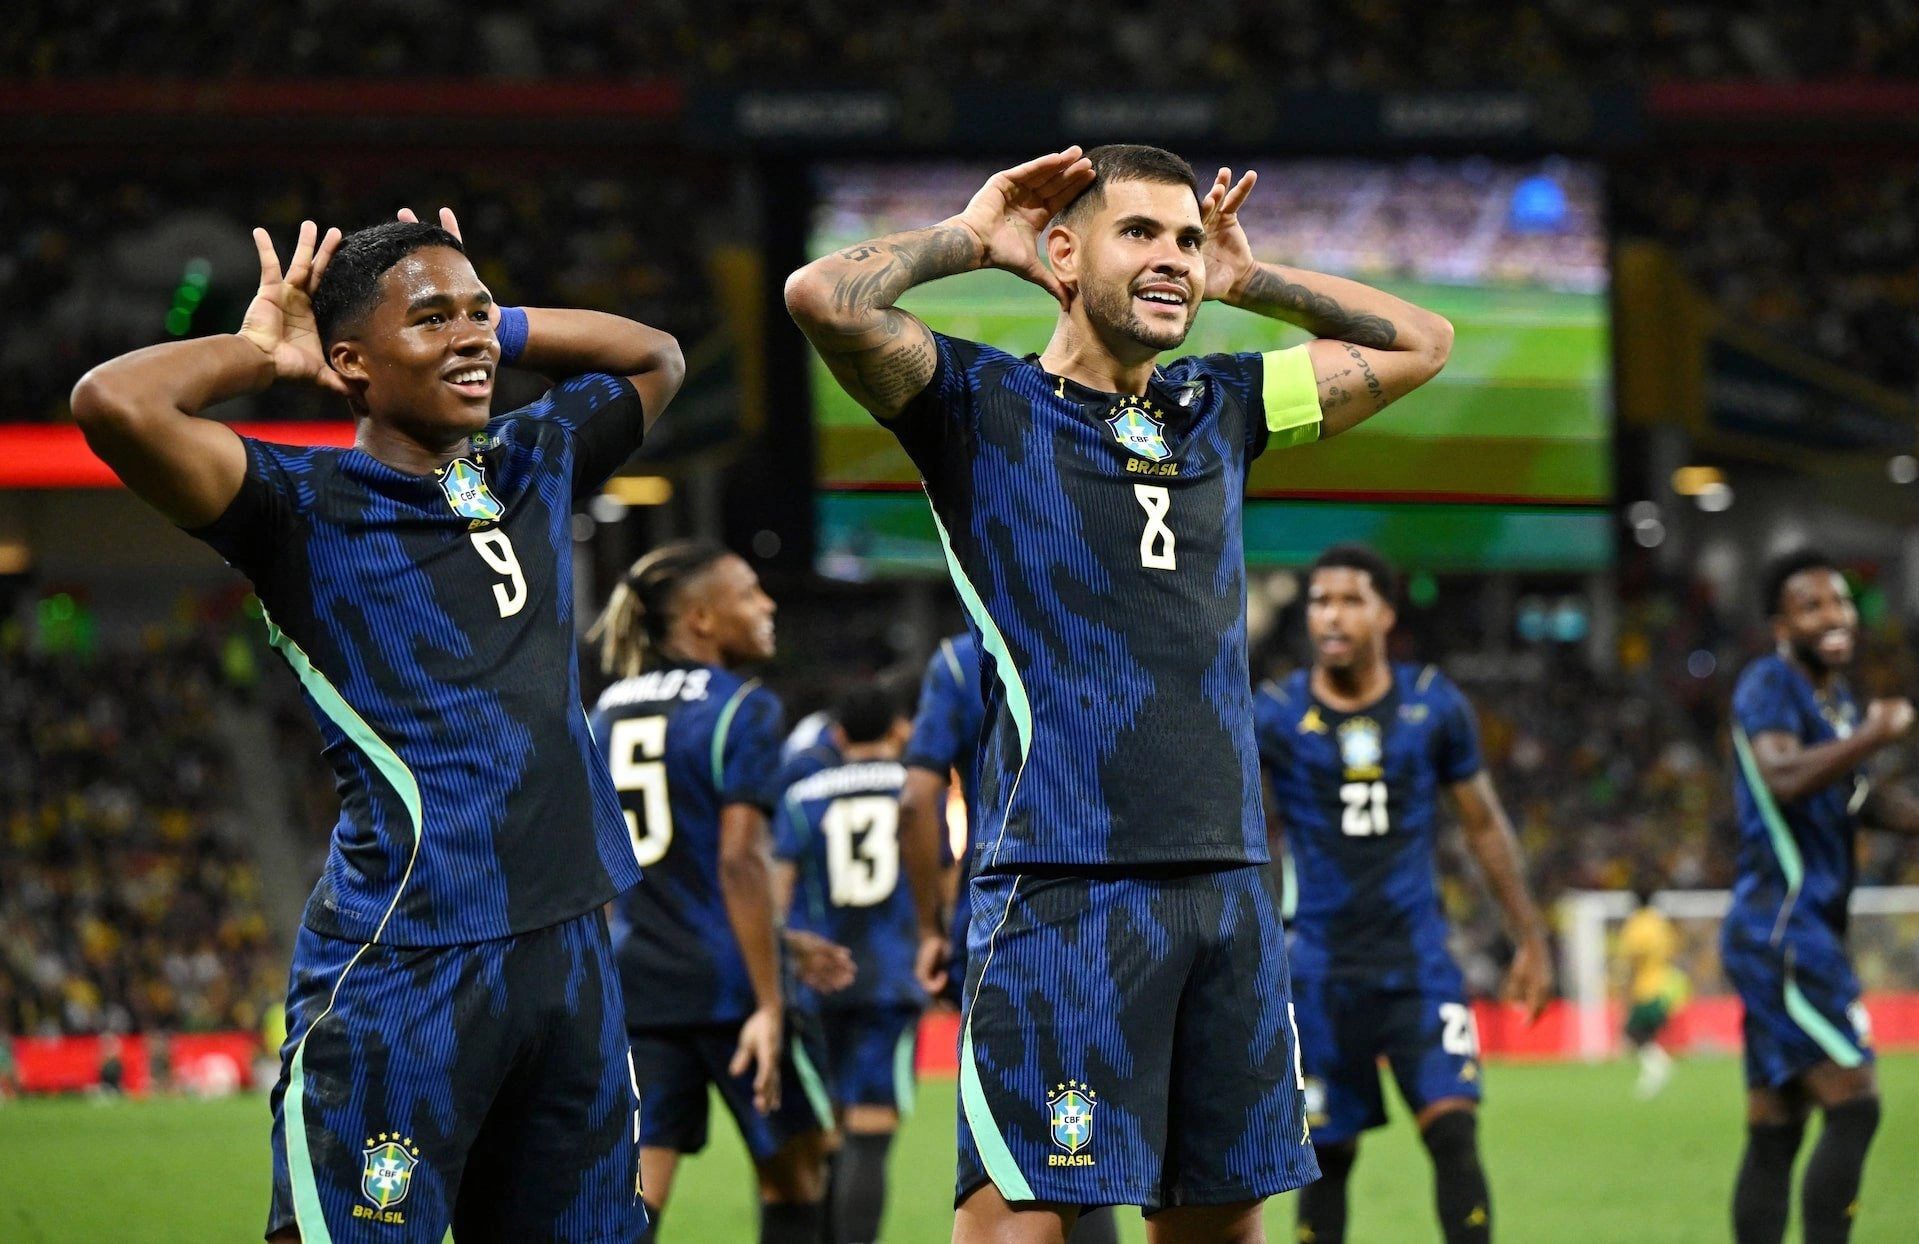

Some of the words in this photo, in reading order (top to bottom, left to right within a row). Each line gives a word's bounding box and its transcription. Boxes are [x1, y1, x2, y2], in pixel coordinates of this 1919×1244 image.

[1130, 435, 1149, 443] CBF
[1126, 457, 1179, 476] BRASIL
[460, 489, 477, 502] CBF
[1134, 483, 1177, 571] 8
[470, 527, 528, 618] 9
[609, 714, 674, 867] 5
[1339, 780, 1389, 836] 21
[820, 795, 900, 908] 13
[1064, 1116, 1081, 1124] CBF
[1048, 1154, 1096, 1167] BRASIL
[378, 1168, 398, 1179] CBF
[352, 1204, 406, 1224] BRASIL
